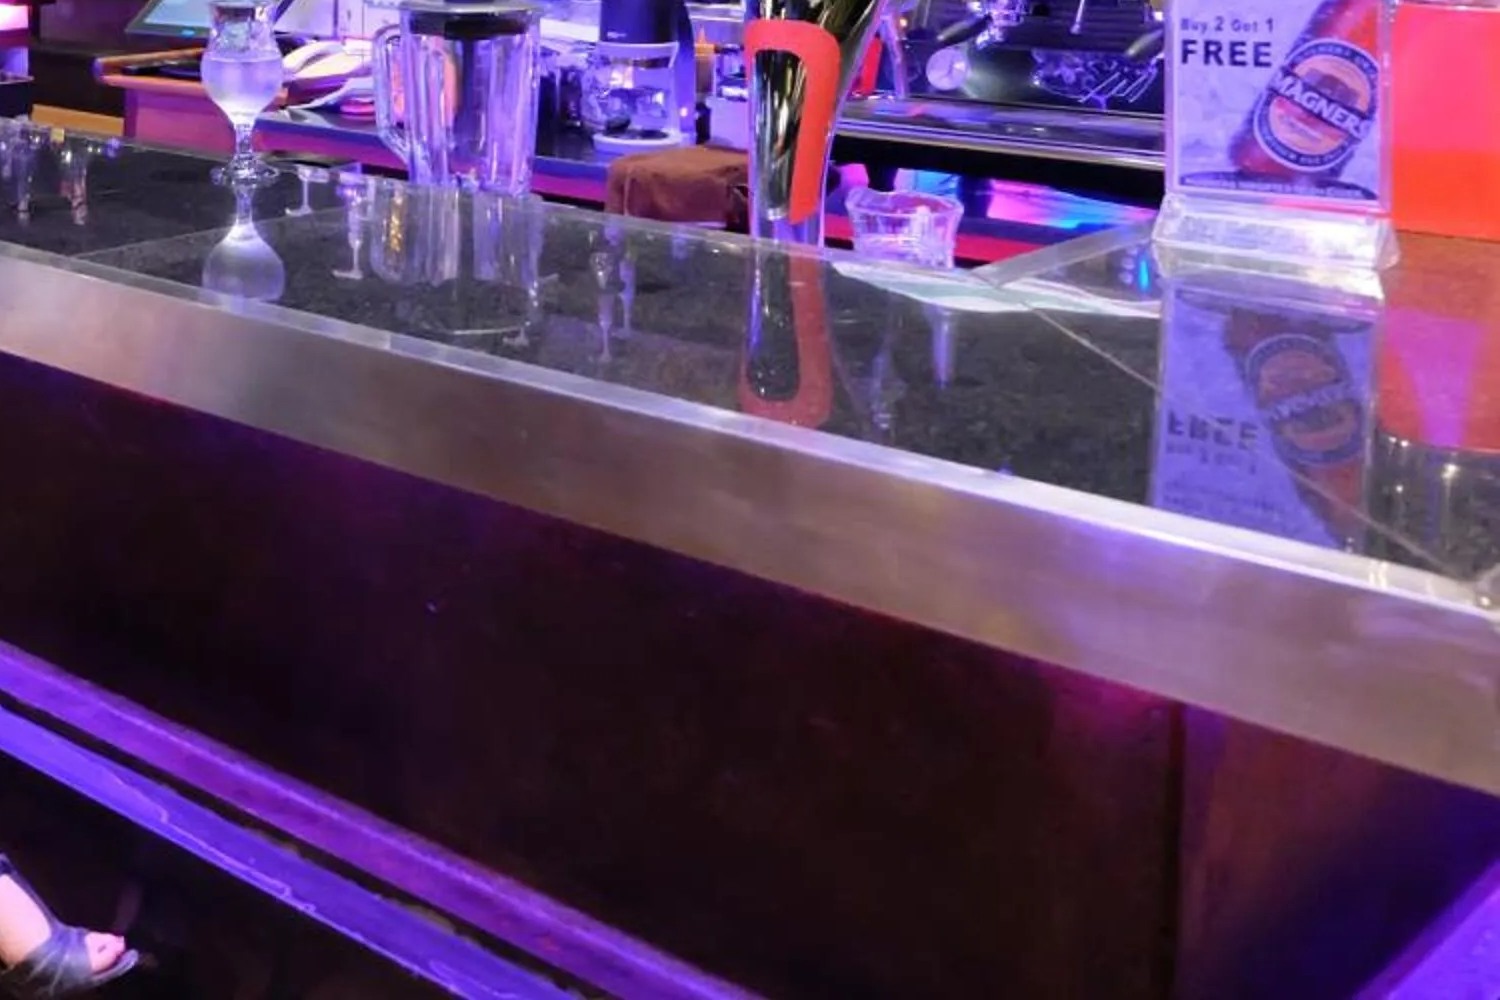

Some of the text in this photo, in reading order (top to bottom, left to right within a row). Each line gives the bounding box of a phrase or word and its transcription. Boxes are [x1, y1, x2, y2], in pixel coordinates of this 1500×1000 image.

[1181, 16, 1274, 34] Buy 2 Get 1
[1181, 39, 1273, 68] FREE
[1267, 68, 1376, 140] MAGNERS
